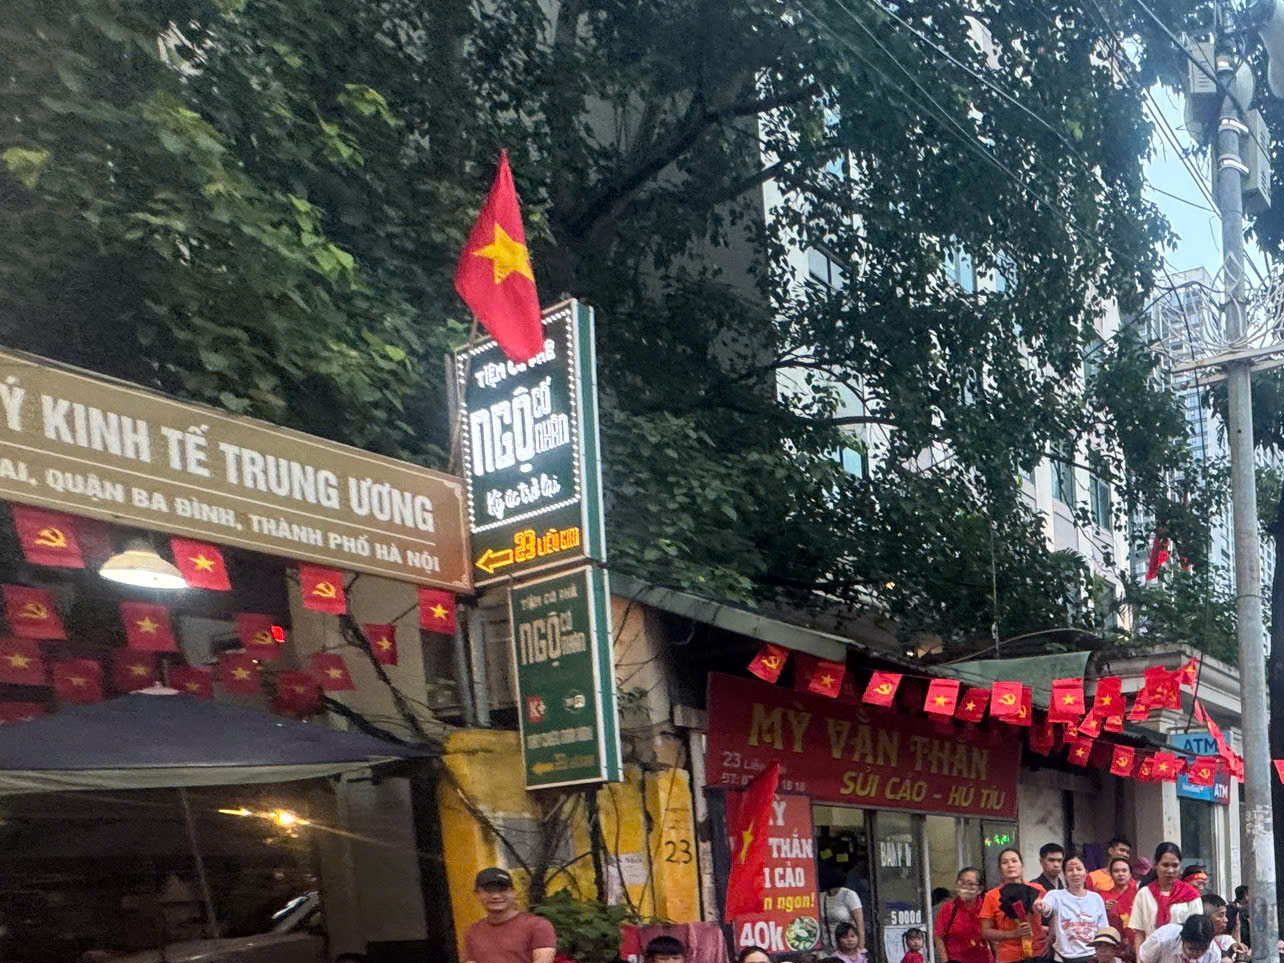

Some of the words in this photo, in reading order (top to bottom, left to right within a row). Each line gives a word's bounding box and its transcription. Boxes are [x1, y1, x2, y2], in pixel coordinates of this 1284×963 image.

[41, 394, 151, 464] KINH
[161, 424, 211, 478] TẾ
[218, 442, 340, 510] TRUNG
[349, 477, 435, 533] ƯƠNG
[46, 468, 125, 503] QUẬN
[132, 487, 169, 512] BA
[174, 496, 242, 531] BÌNH,
[248, 514, 324, 546] THÀNH
[327, 535, 371, 557] PHỐ
[375, 543, 403, 564] HÀ
[407, 550, 440, 574] NỘI
[513, 529, 537, 563] 23
[1184, 738, 1219, 753] ATM
[723, 752, 741, 768] 23
[840, 766, 880, 798] SỦI
[1213, 783, 1229, 799] ATM
[664, 839, 692, 864] 23
[768, 828, 814, 859] THẮN
[774, 862, 806, 888] CẢO
[777, 892, 816, 912] ngon!
[739, 921, 786, 952] 40k
